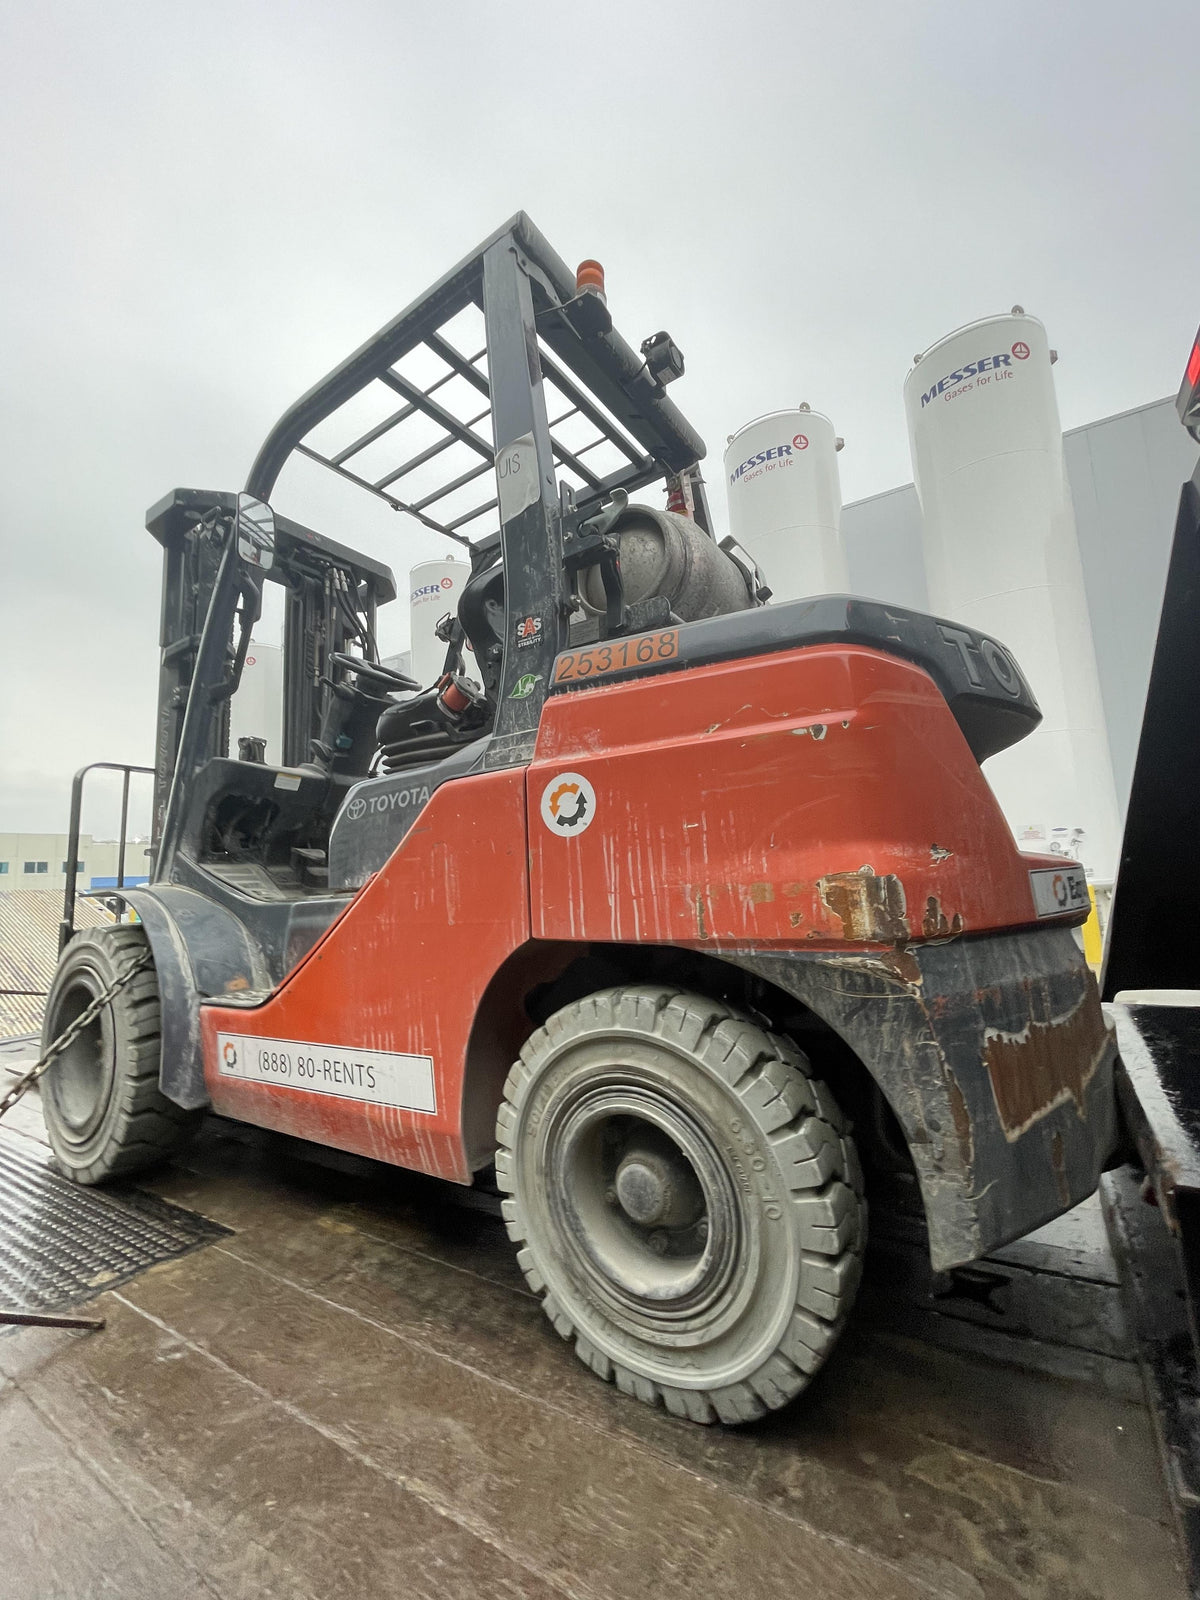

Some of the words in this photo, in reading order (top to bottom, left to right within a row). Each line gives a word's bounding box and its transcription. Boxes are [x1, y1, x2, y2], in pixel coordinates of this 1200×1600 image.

[920, 354, 1012, 408] MESSER
[944, 382, 974, 402] Gases
[976, 375, 992, 386] for
[995, 369, 1014, 381] Life
[730, 444, 793, 486] MESSER
[743, 468, 763, 483] Gases
[765, 463, 777, 472] for
[779, 458, 794, 468] Life
[517, 617, 542, 638] SAS
[557, 631, 676, 681] 253168
[369, 786, 430, 814] TOYOTA
[258, 1049, 292, 1078] (888)
[297, 1056, 377, 1089] 80-RENTS
